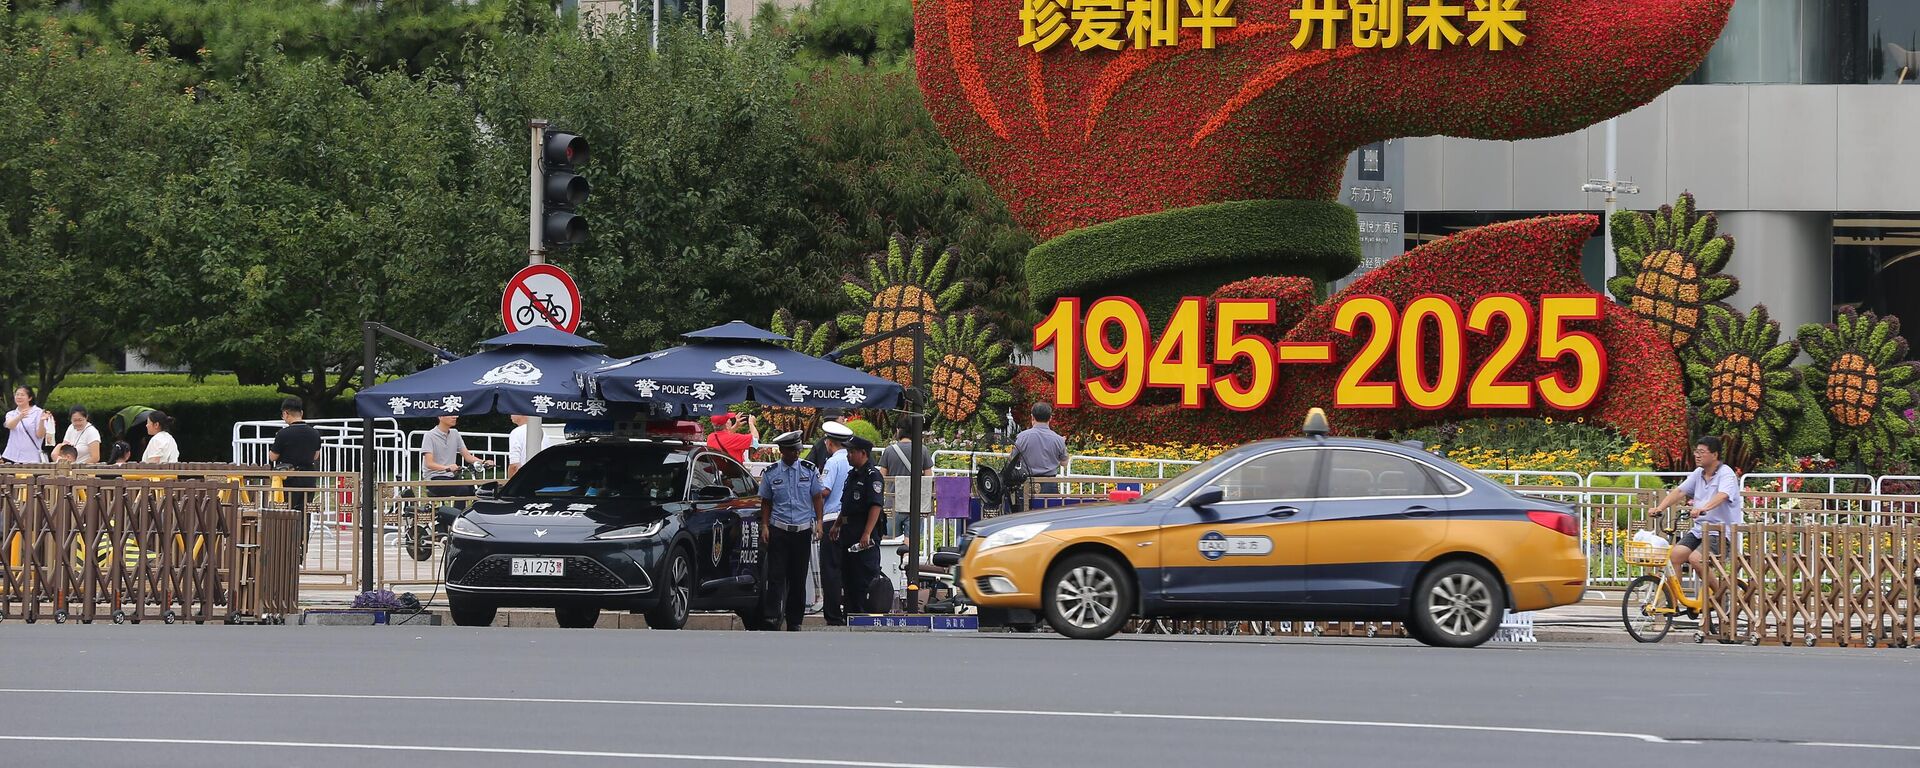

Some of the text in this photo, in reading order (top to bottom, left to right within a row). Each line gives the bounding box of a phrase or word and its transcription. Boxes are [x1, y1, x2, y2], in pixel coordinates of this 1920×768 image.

[1018, 0, 1527, 52] 珍爱和平 开创未来
[1350, 186, 1393, 203] 东方广场
[1033, 293, 1608, 411] 1945-2025
[634, 378, 716, 401] 警 POLICE 察
[785, 383, 867, 404] 警 POLICE 察
[388, 394, 464, 415] 警 POLICE 察
[531, 394, 608, 417] 警 POLICE 察
[514, 509, 586, 518] POLICE
[741, 521, 759, 548] 特警
[740, 549, 758, 564] POLICE
